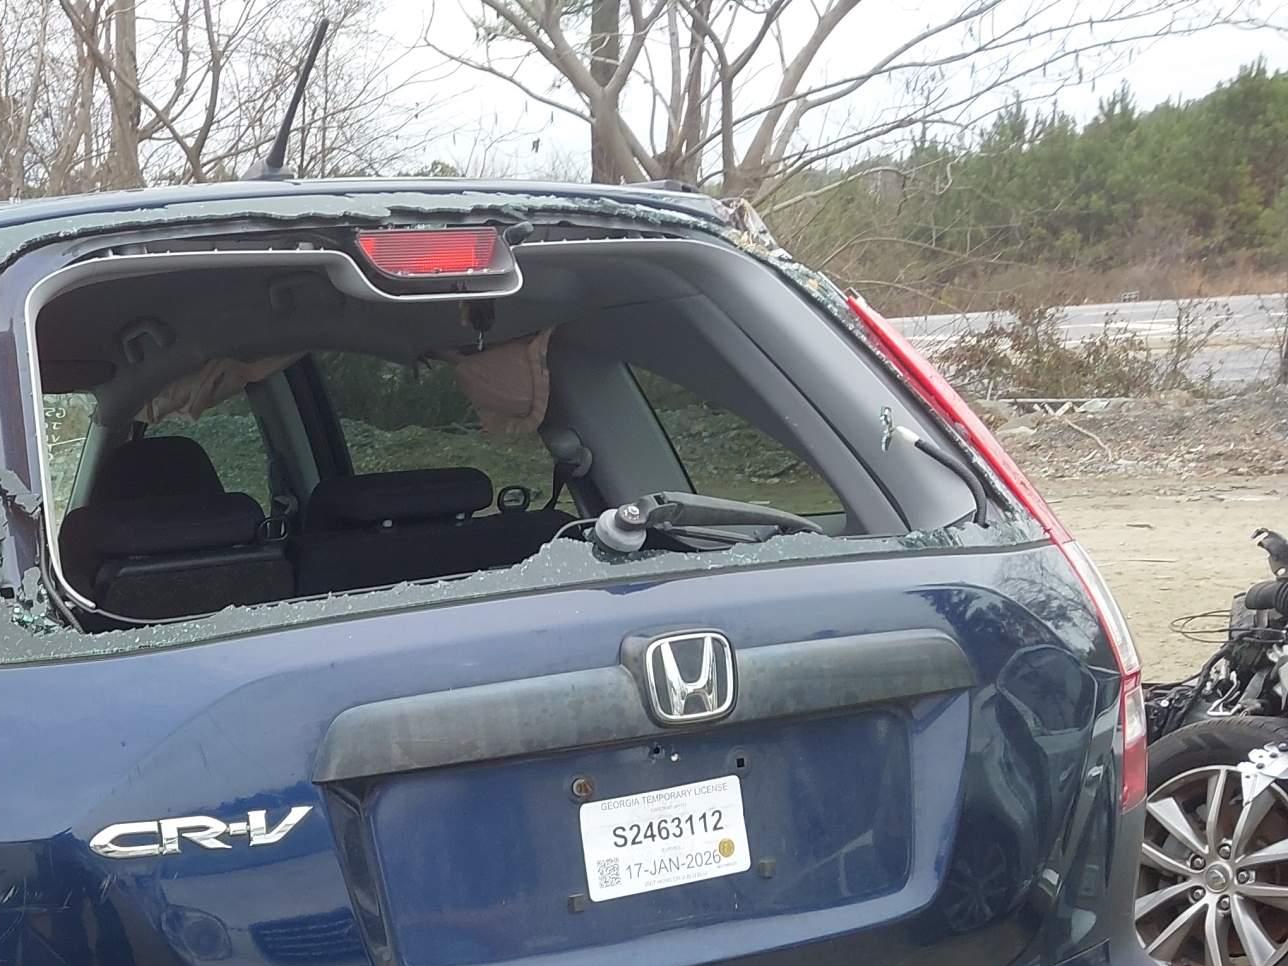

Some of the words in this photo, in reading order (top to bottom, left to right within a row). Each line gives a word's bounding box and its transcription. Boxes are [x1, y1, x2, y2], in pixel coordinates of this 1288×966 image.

[600, 797, 640, 812] GEORGIA
[642, 788, 693, 805] TEMPORARY
[694, 782, 729, 796] LICENSE
[89, 806, 314, 858] CR-V
[612, 809, 725, 848] S2463112
[624, 848, 722, 880] 17-JAN-2026
